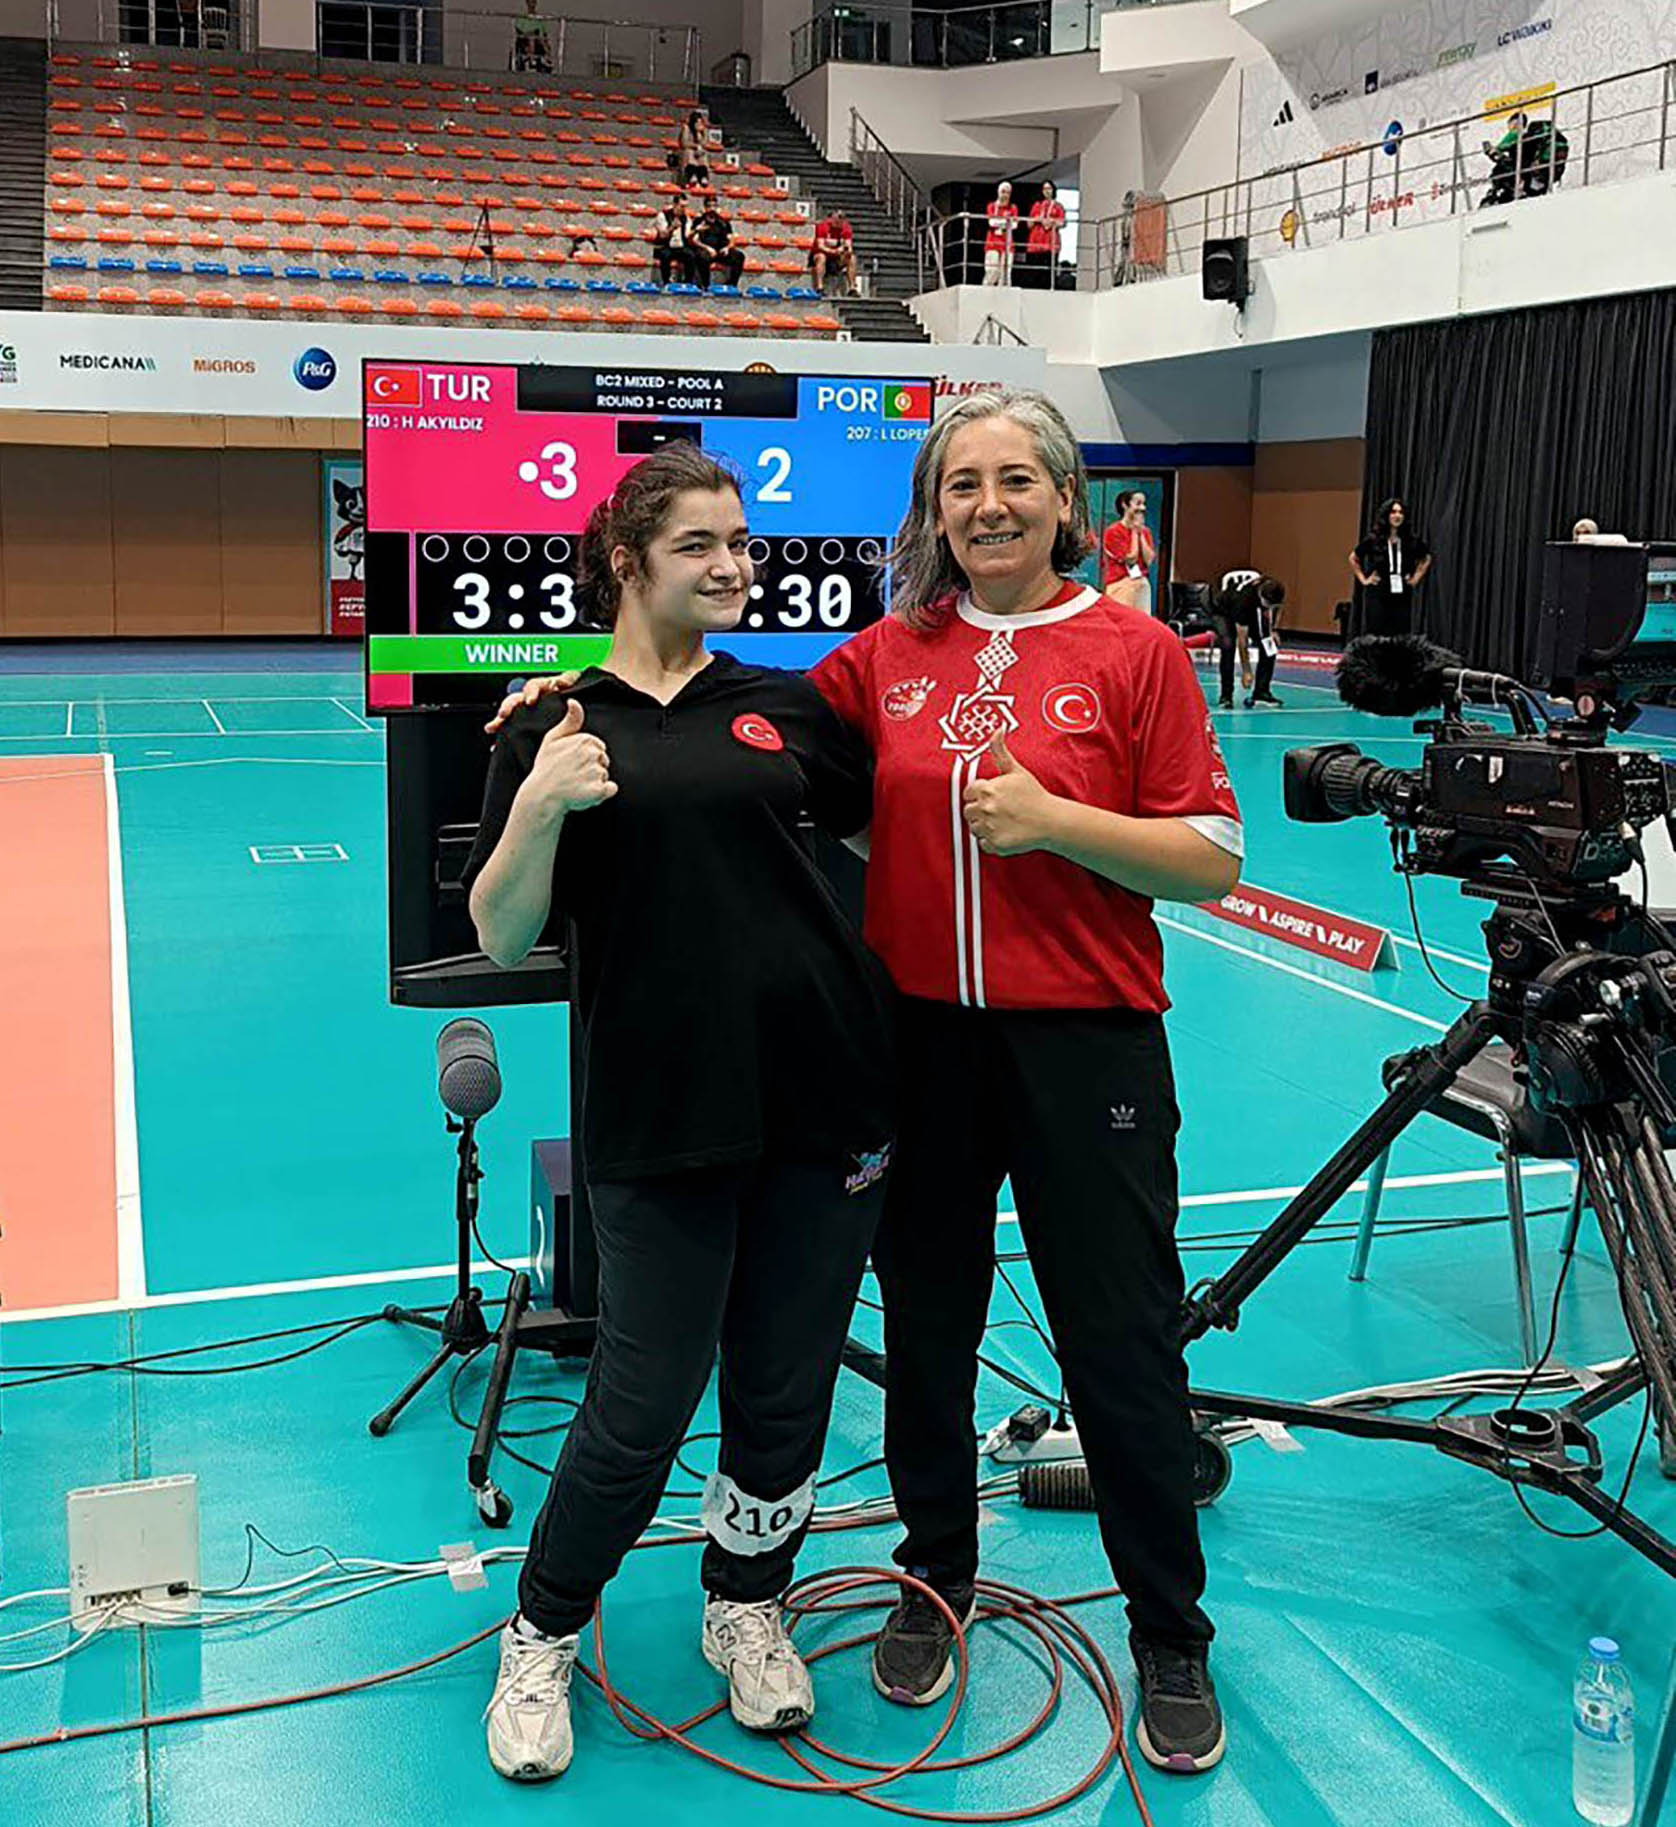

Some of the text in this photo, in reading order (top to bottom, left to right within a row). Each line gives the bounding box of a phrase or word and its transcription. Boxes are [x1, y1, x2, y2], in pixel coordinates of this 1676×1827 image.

[60, 355, 145, 371] MEDICANA
[302, 361, 334, 378] P&G
[427, 374, 492, 402] TUR
[595, 374, 622, 387] BC2
[624, 376, 665, 388] MIXED
[677, 378, 711, 390] POOL
[714, 379, 724, 390] A
[597, 395, 644, 408] ROUND
[646, 396, 654, 408] 3
[667, 397, 712, 410] COURT
[714, 398, 722, 410] 2
[818, 387, 878, 413] POR
[366, 414, 390, 428] 210
[402, 416, 413, 428] H
[416, 417, 483, 431] AKYILDIZ
[847, 426, 871, 441] 207
[756, 447, 792, 502] 2
[464, 644, 559, 663] WINNER
[1221, 894, 1366, 954] GROW ASPIRE PLAY
